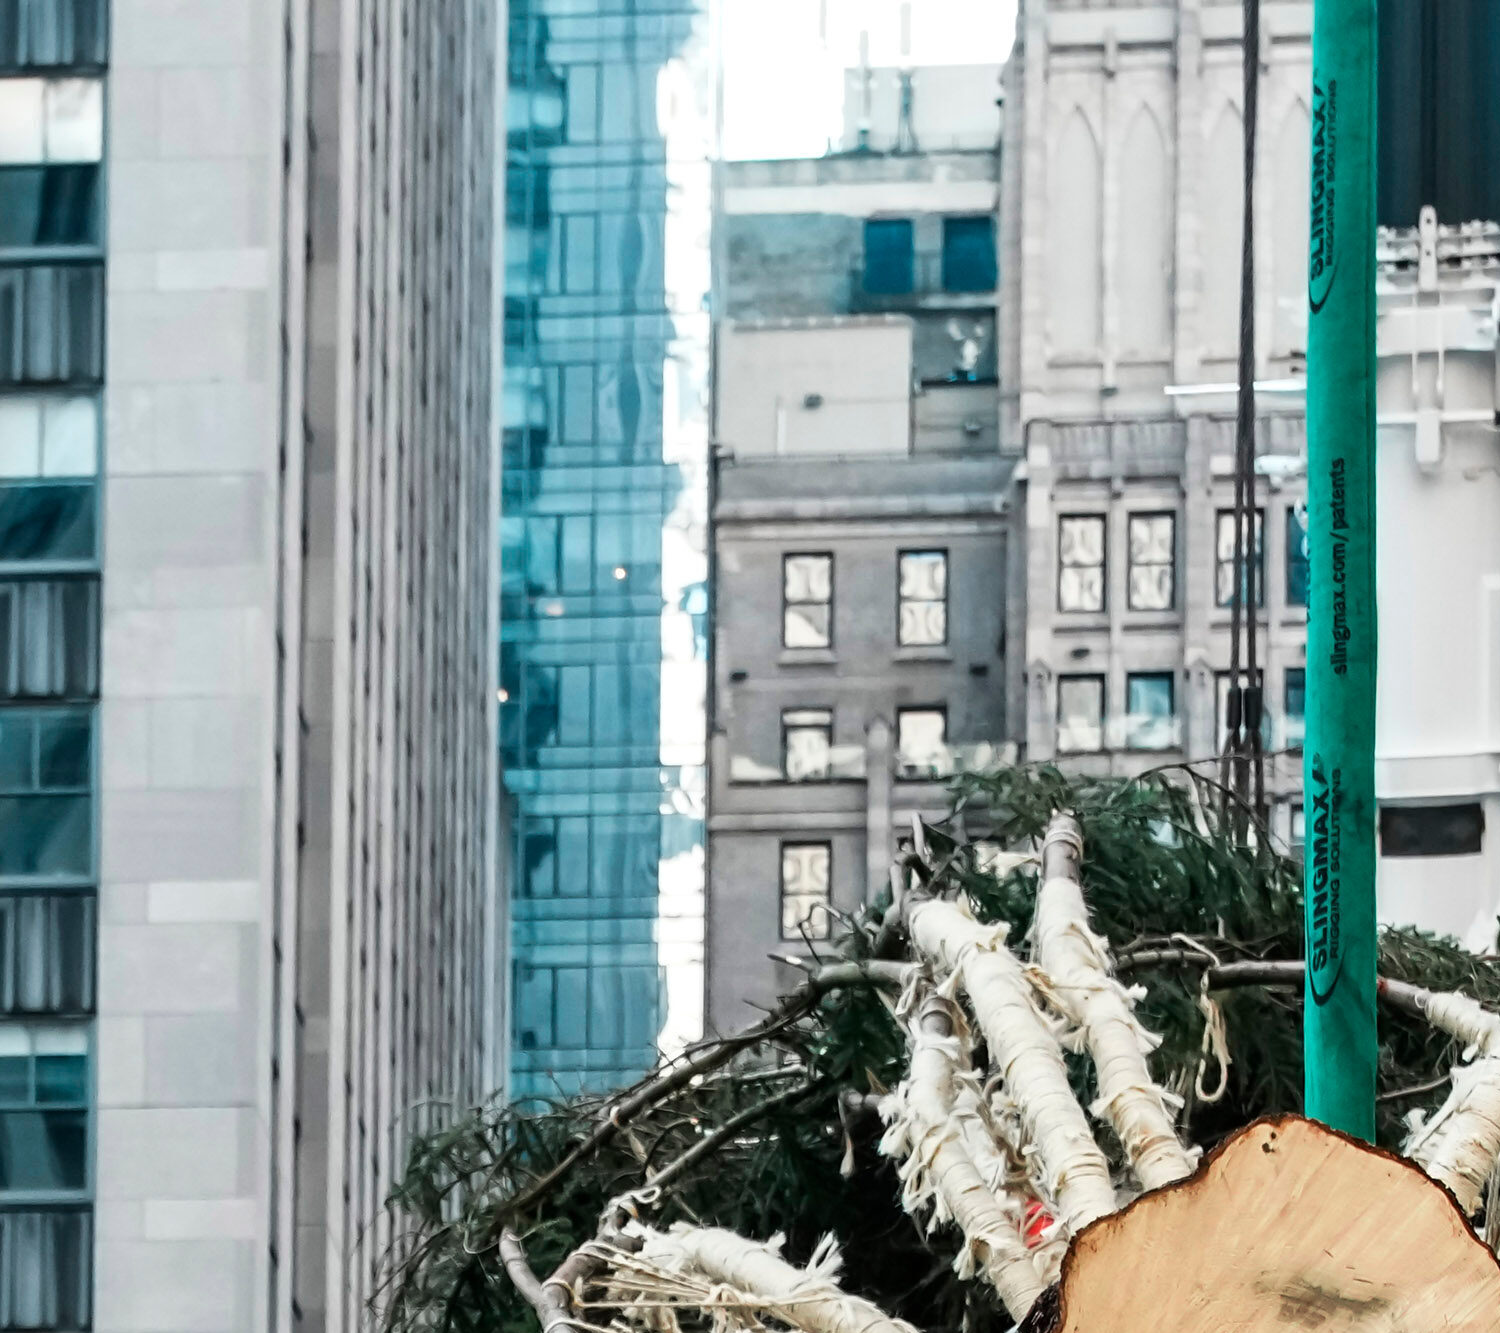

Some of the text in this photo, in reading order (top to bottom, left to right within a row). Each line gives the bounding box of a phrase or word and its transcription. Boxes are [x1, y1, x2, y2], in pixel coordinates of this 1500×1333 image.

[1329, 456, 1351, 676] slingmax.com/patents
[1312, 788, 1330, 973] SLINGMAX
[1329, 879, 1341, 960] RIGGING
